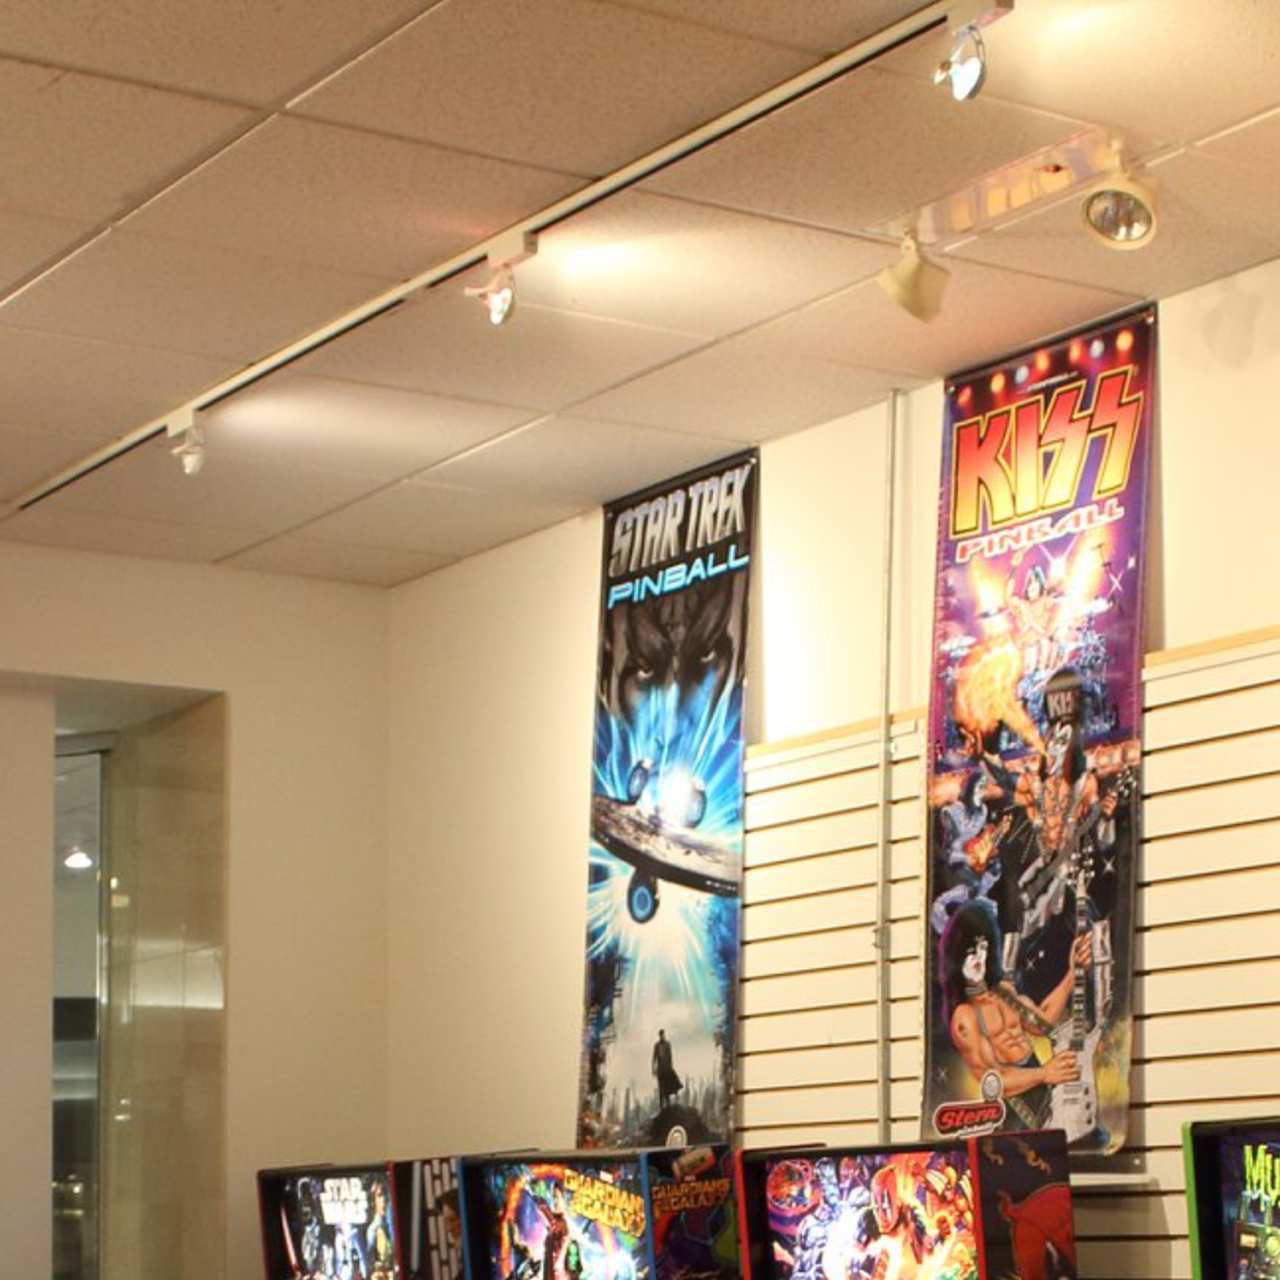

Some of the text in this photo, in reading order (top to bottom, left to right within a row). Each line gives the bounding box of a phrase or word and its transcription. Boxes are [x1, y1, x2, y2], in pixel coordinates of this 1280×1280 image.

[949, 364, 1144, 539] KISS
[608, 464, 751, 578] STAR TREK
[956, 498, 1125, 563] PINBALL
[607, 544, 751, 610] PINBALL
[321, 1178, 366, 1201] STAR
[321, 1199, 368, 1224] WARS
